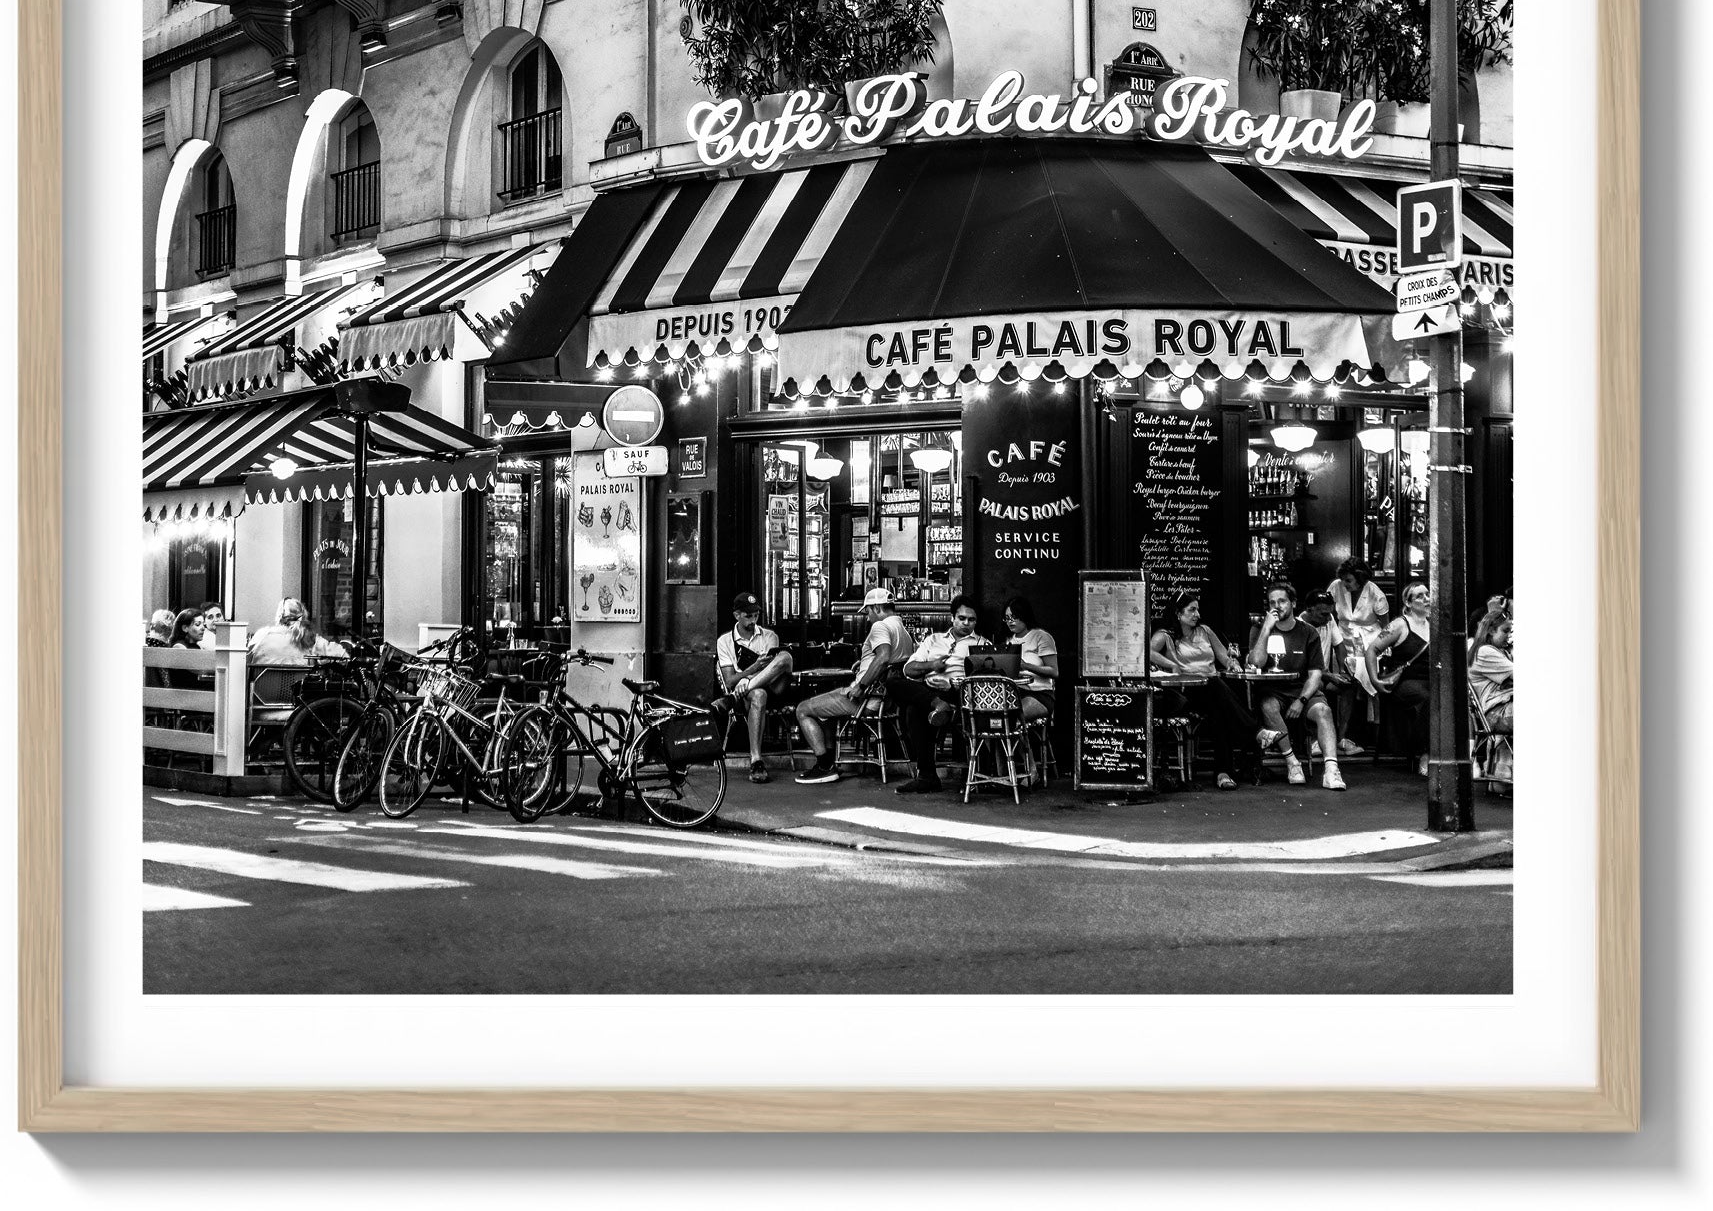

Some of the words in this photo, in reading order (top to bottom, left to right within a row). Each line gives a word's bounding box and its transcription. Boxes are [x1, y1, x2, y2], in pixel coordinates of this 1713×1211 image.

[1135, 10, 1154, 28] 202
[1130, 77, 1156, 92] RUE
[687, 90, 831, 170] Café
[844, 70, 1134, 144] Palais
[1155, 76, 1377, 166] Royal
[1413, 201, 1438, 254] P
[1463, 260, 1513, 288] ARIS
[1407, 280, 1425, 292] CROIX
[1426, 276, 1438, 288] DES
[1399, 294, 1421, 308] PETITS
[1422, 285, 1455, 303] CHAMPS
[656, 311, 734, 342] DEPUIS
[866, 322, 954, 368] CAFÉ
[971, 319, 1132, 362] PALAIS
[1154, 319, 1304, 358] ROYAL
[1134, 411, 1160, 425] Poulet
[1190, 414, 1213, 432] four
[623, 450, 650, 459] SAUF
[685, 444, 699, 454] RUE
[987, 440, 1067, 468] CAFÉ
[681, 460, 703, 472] VALOIS
[580, 483, 608, 496] PALAIS
[609, 482, 635, 495] ROYAL
[998, 472, 1030, 488] Depuis
[1032, 472, 1056, 483] 1903
[979, 497, 1030, 521] PALAIS
[1031, 496, 1081, 521] ROYAL
[995, 532, 1061, 543] SERVICE
[994, 548, 1060, 559] CONTINU
